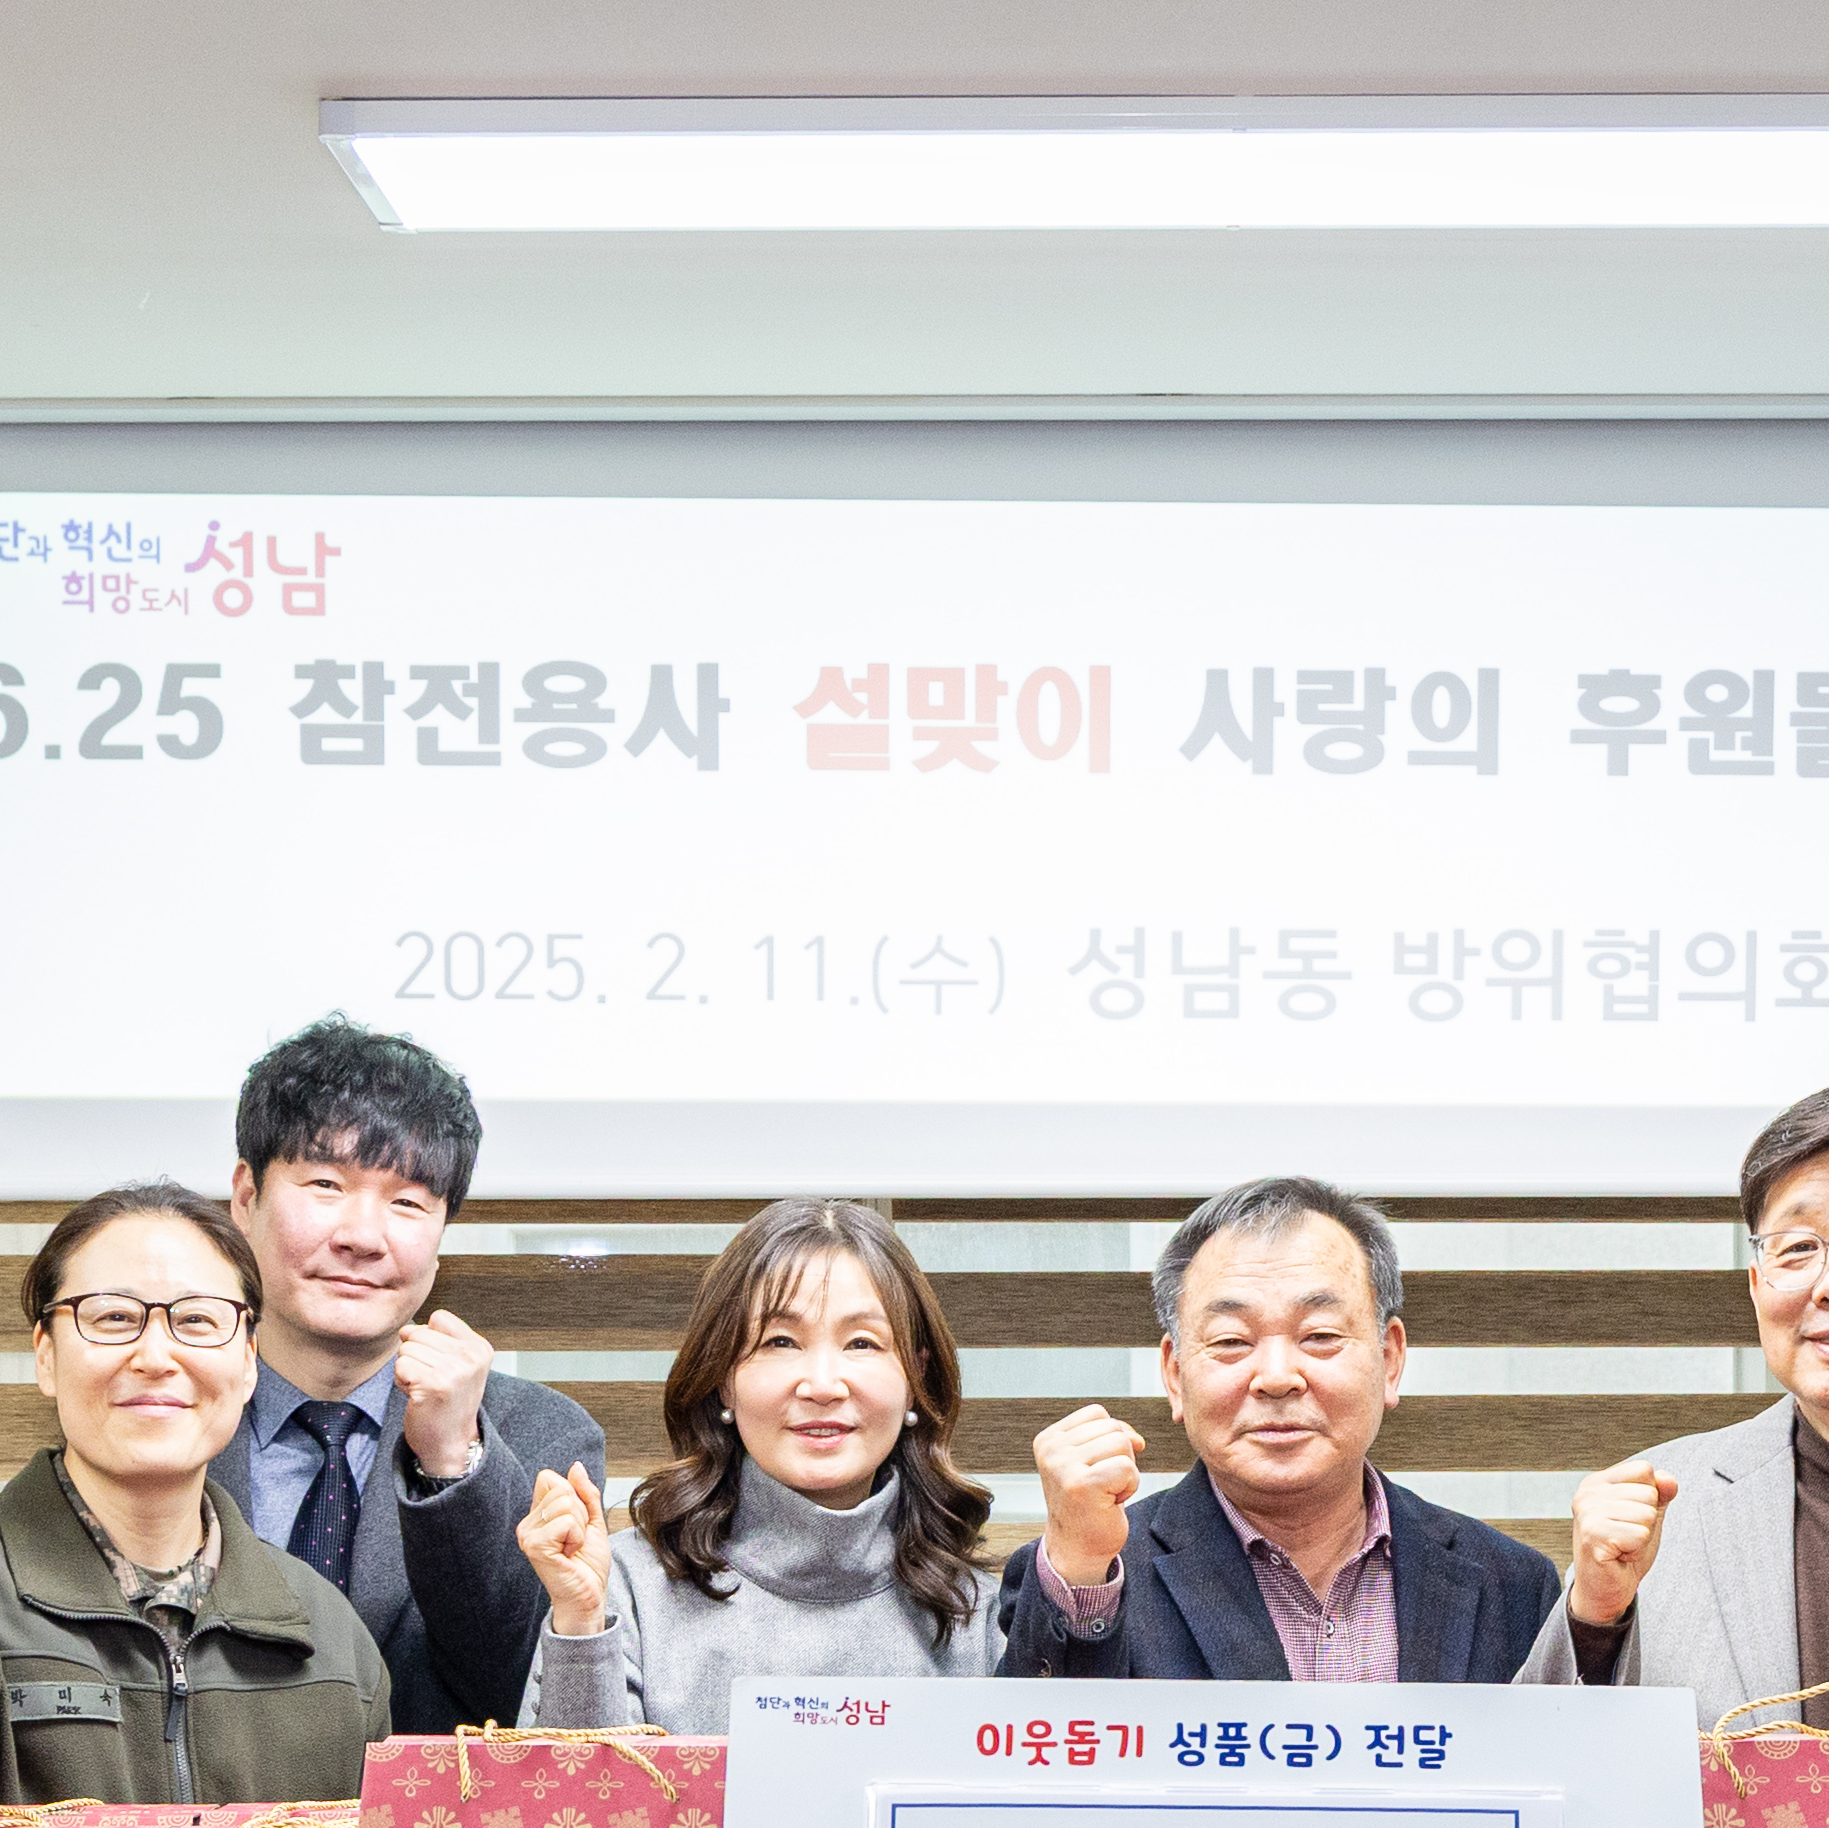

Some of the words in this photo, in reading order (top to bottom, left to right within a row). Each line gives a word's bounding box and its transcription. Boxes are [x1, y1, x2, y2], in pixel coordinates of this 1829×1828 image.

[61, 519, 161, 564] 혁신의
[184, 520, 341, 617] 성남
[62, 571, 190, 615] 희망도시
[288, 658, 731, 772] 참전용사
[793, 663, 1112, 774] 설맞이
[1179, 665, 1499, 778] 사랑의
[393, 930, 607, 1004] 2025.
[645, 933, 708, 1005] 2.
[1067, 926, 1353, 1022] 성남동
[756, 1697, 790, 1709] 첨단과
[794, 1697, 828, 1710] 혁신의
[793, 1712, 838, 1725] 희망도시
[836, 1697, 890, 1725] 성남
[976, 1719, 1144, 1766] 이웃돕기
[1168, 1722, 1342, 1767] 성품(금)
[1365, 1724, 1452, 1769] 전달
